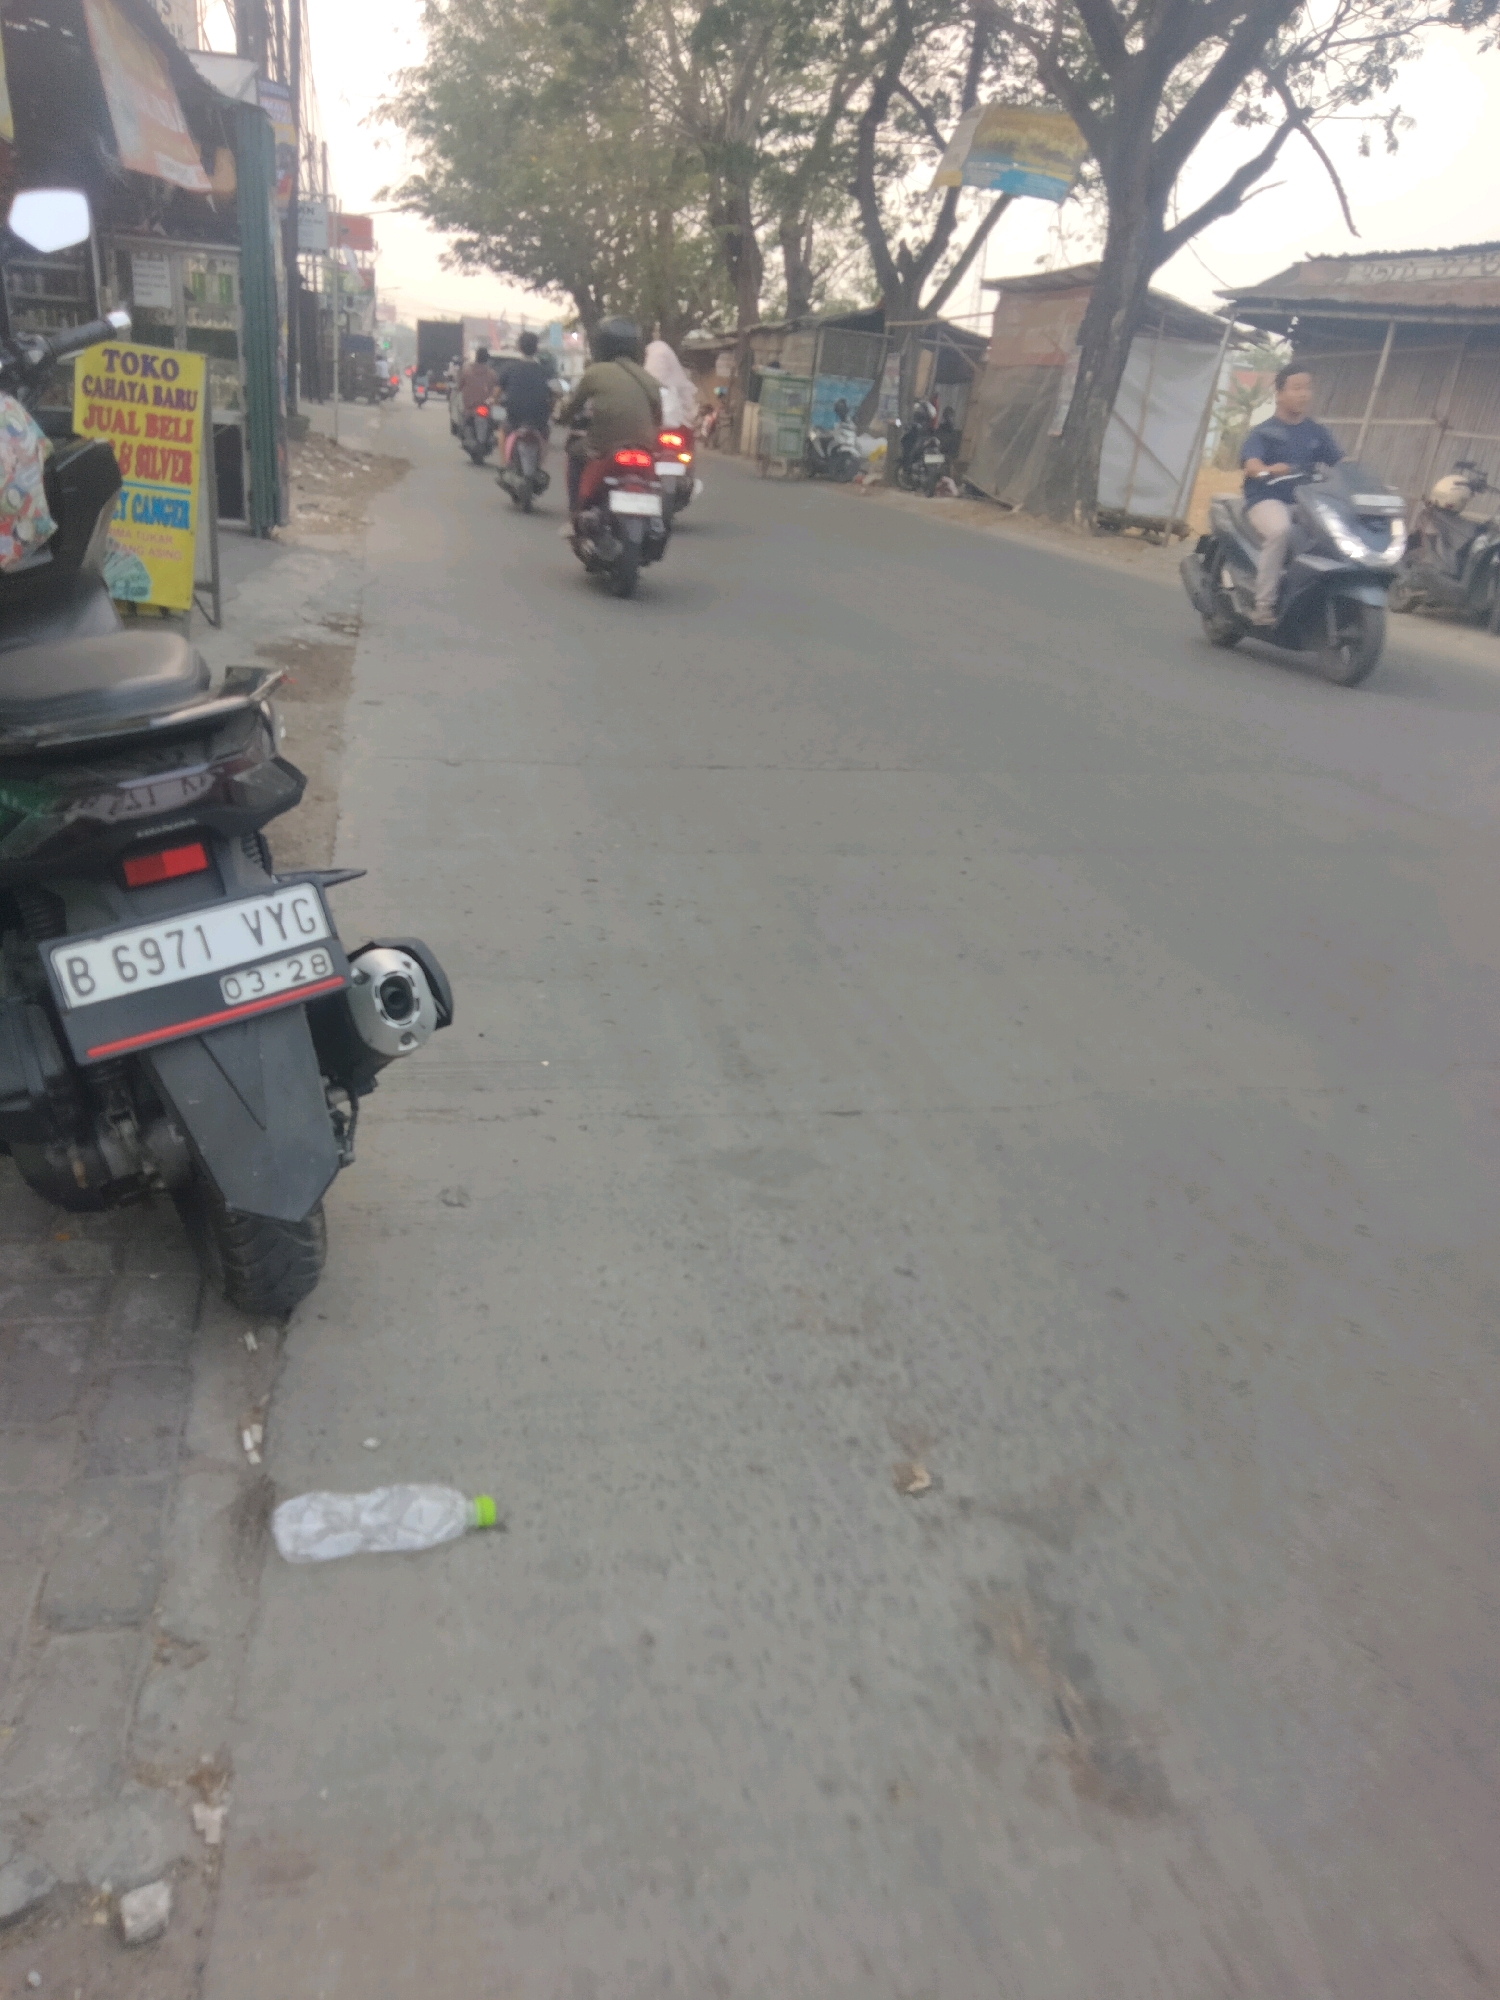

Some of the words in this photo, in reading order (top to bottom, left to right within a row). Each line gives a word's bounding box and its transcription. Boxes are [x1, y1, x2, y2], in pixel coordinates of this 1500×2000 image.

[102, 348, 180, 382] TOKO
[81, 374, 149, 405] CAHAYA
[152, 384, 198, 412] BARU
[82, 404, 141, 437] JUAL
[144, 412, 194, 444] BELI
[135, 443, 193, 486] SILVER
[65, 955, 97, 998] B
[111, 924, 212, 984] 6971
[240, 897, 317, 947] VYG
